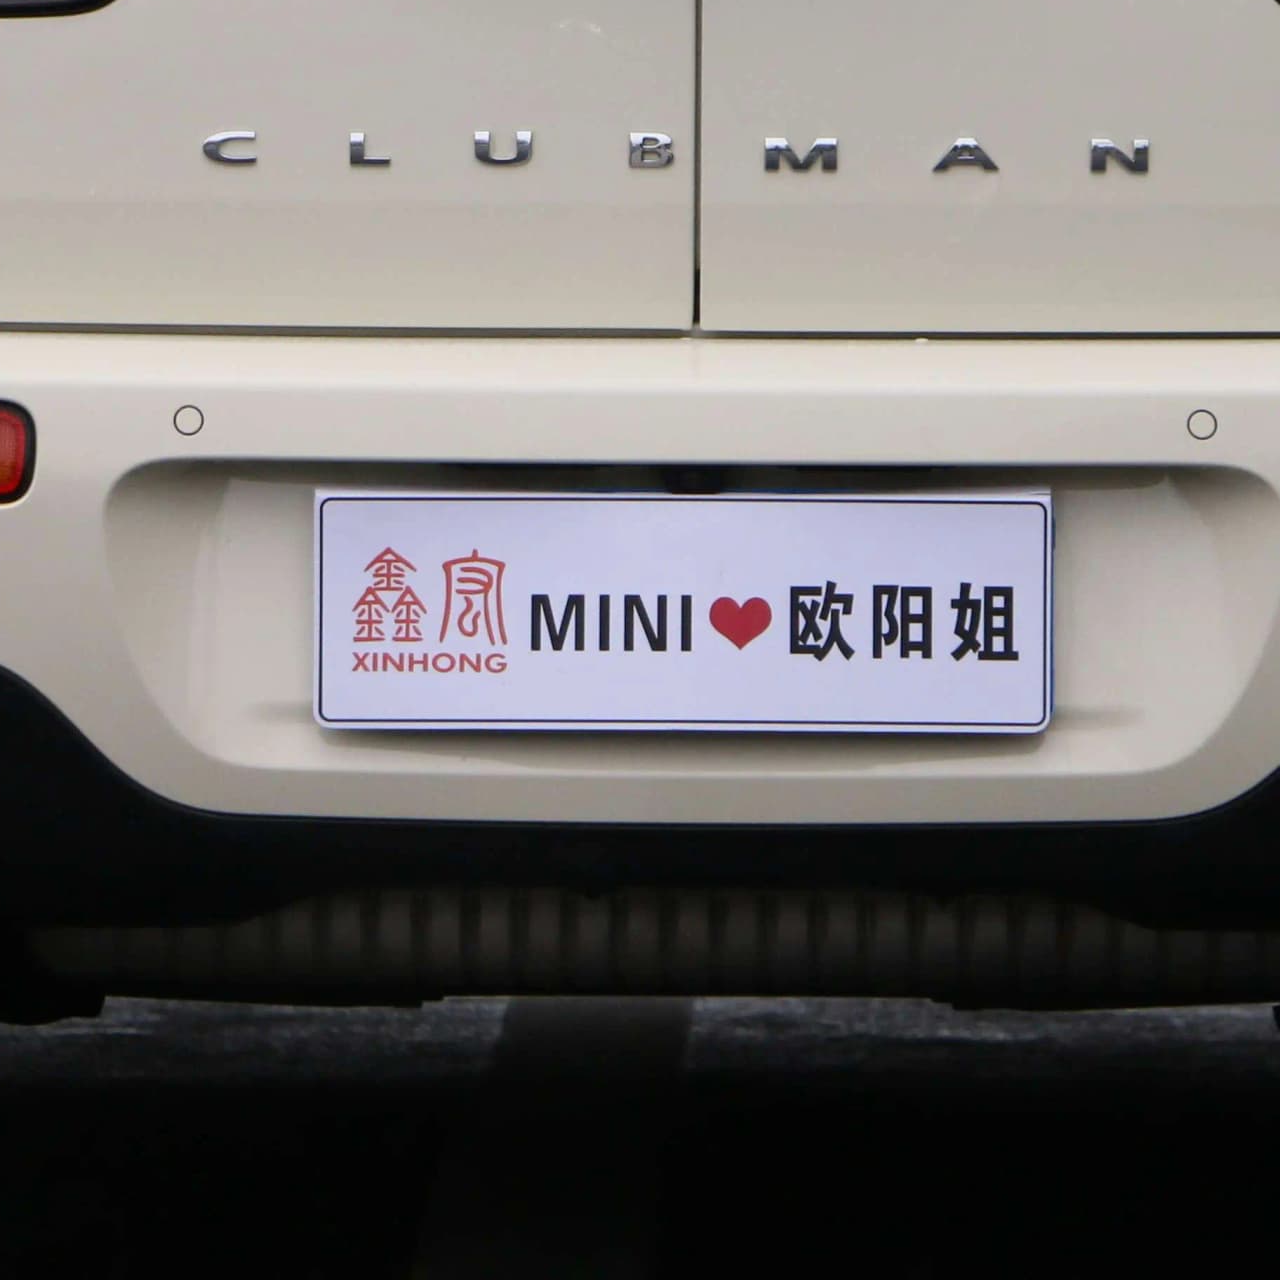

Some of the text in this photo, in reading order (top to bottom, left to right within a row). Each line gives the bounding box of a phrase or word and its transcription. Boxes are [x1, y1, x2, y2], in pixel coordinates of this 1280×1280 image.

[202, 130, 1149, 172] CLUBMAN
[530, 581, 1019, 662] MINI 欧阳姐
[351, 651, 508, 674] XINHONG
